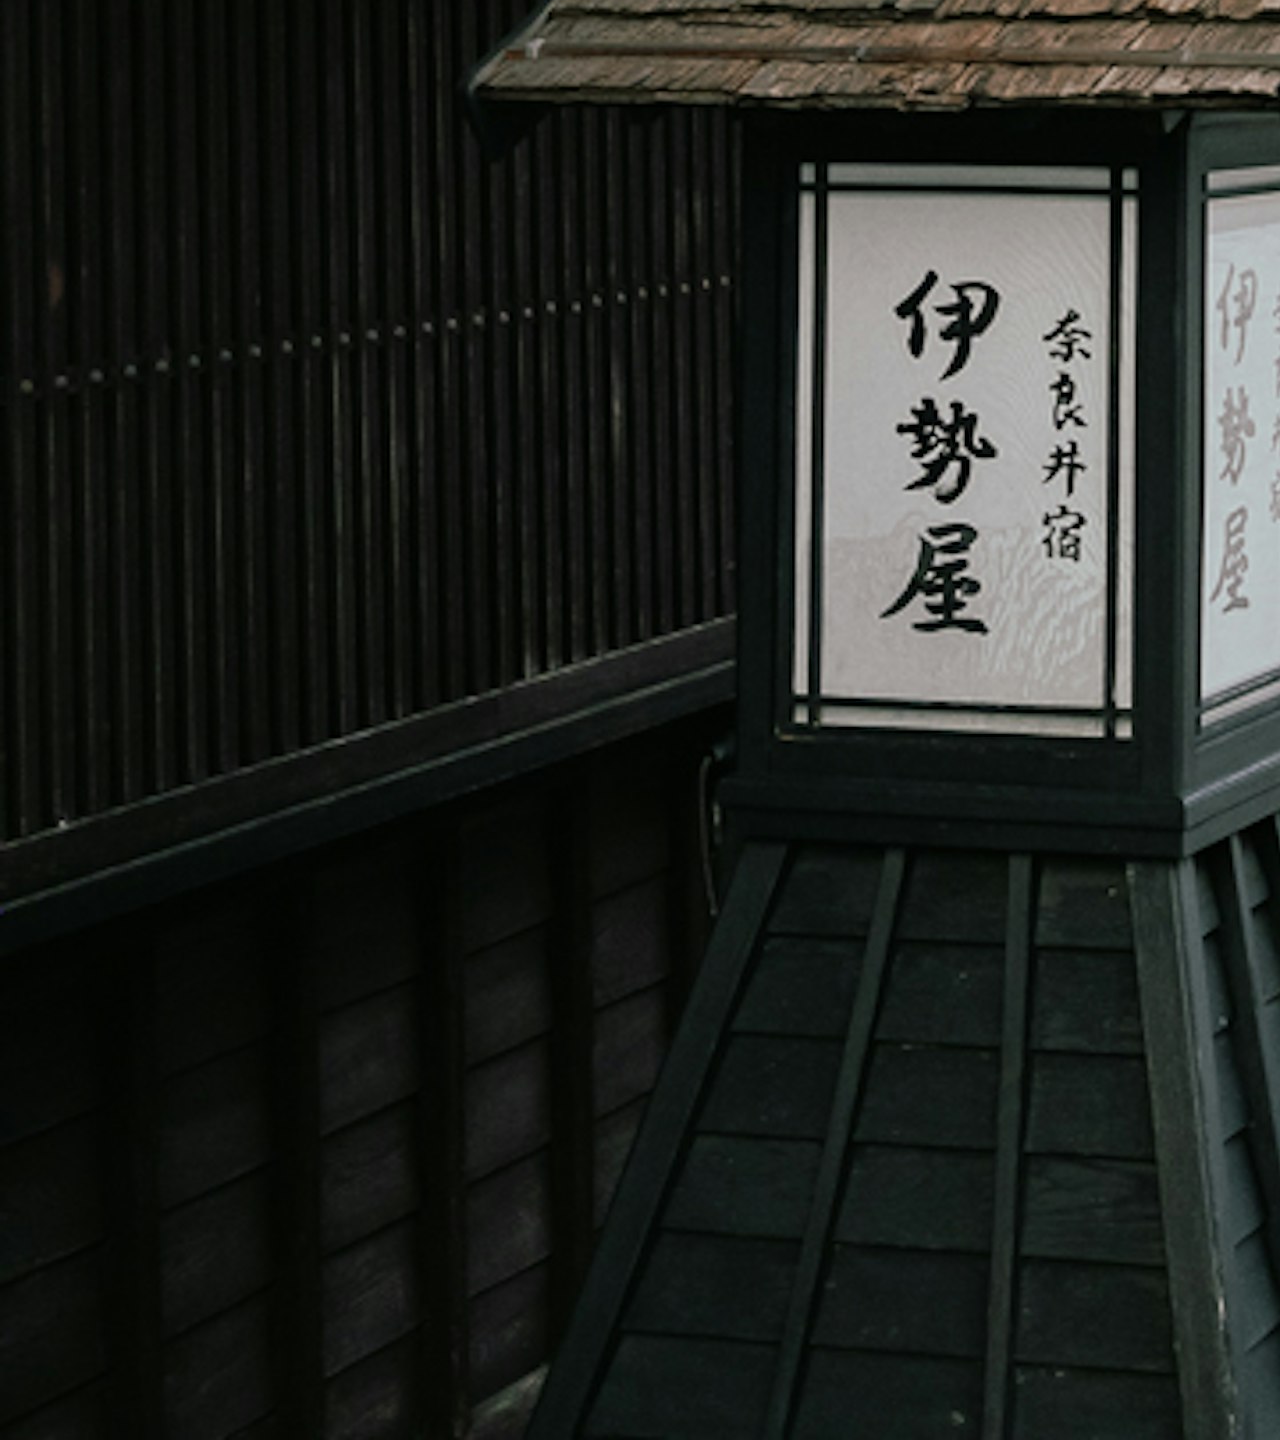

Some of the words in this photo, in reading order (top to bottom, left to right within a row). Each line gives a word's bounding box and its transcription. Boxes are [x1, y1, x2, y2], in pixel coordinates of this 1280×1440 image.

[880, 269, 1001, 636] 伊勢屋
[1042, 309, 1097, 564] 奈良井宿
[1210, 261, 1260, 615] 伊勢屋
